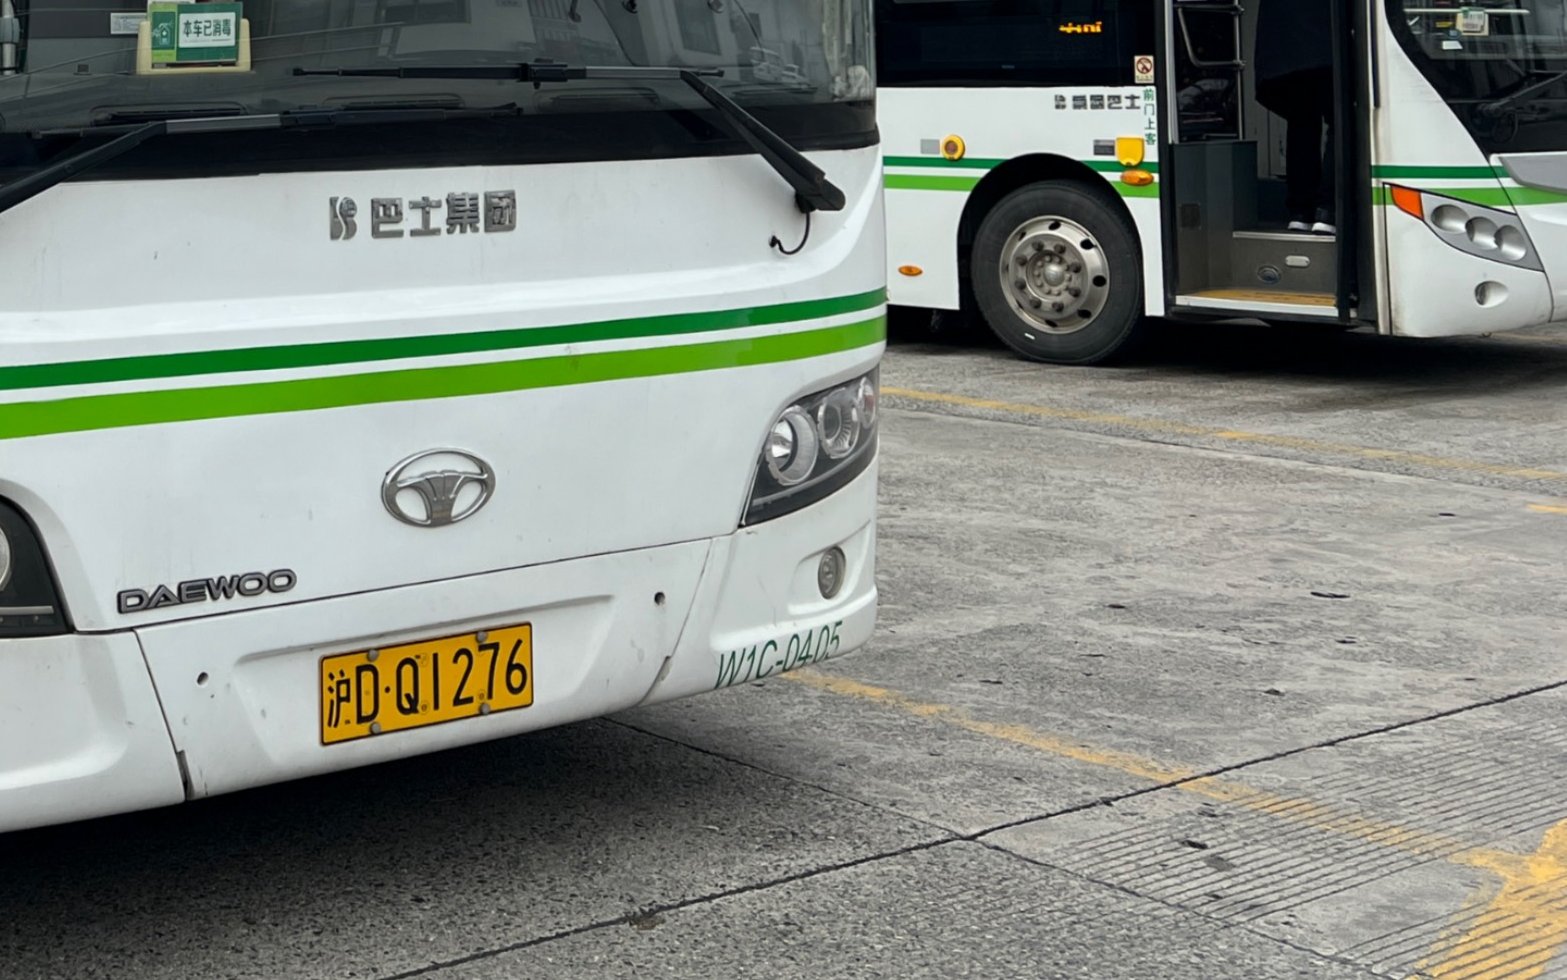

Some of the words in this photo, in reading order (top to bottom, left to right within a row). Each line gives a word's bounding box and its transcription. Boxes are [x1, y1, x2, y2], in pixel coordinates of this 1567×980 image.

[183, 19, 232, 37] 本车已消毒
[1143, 87, 1157, 146] 前门上客
[370, 189, 518, 239] 巴士集团
[117, 568, 297, 614] DAEWOO
[714, 620, 843, 689] W1C-0405
